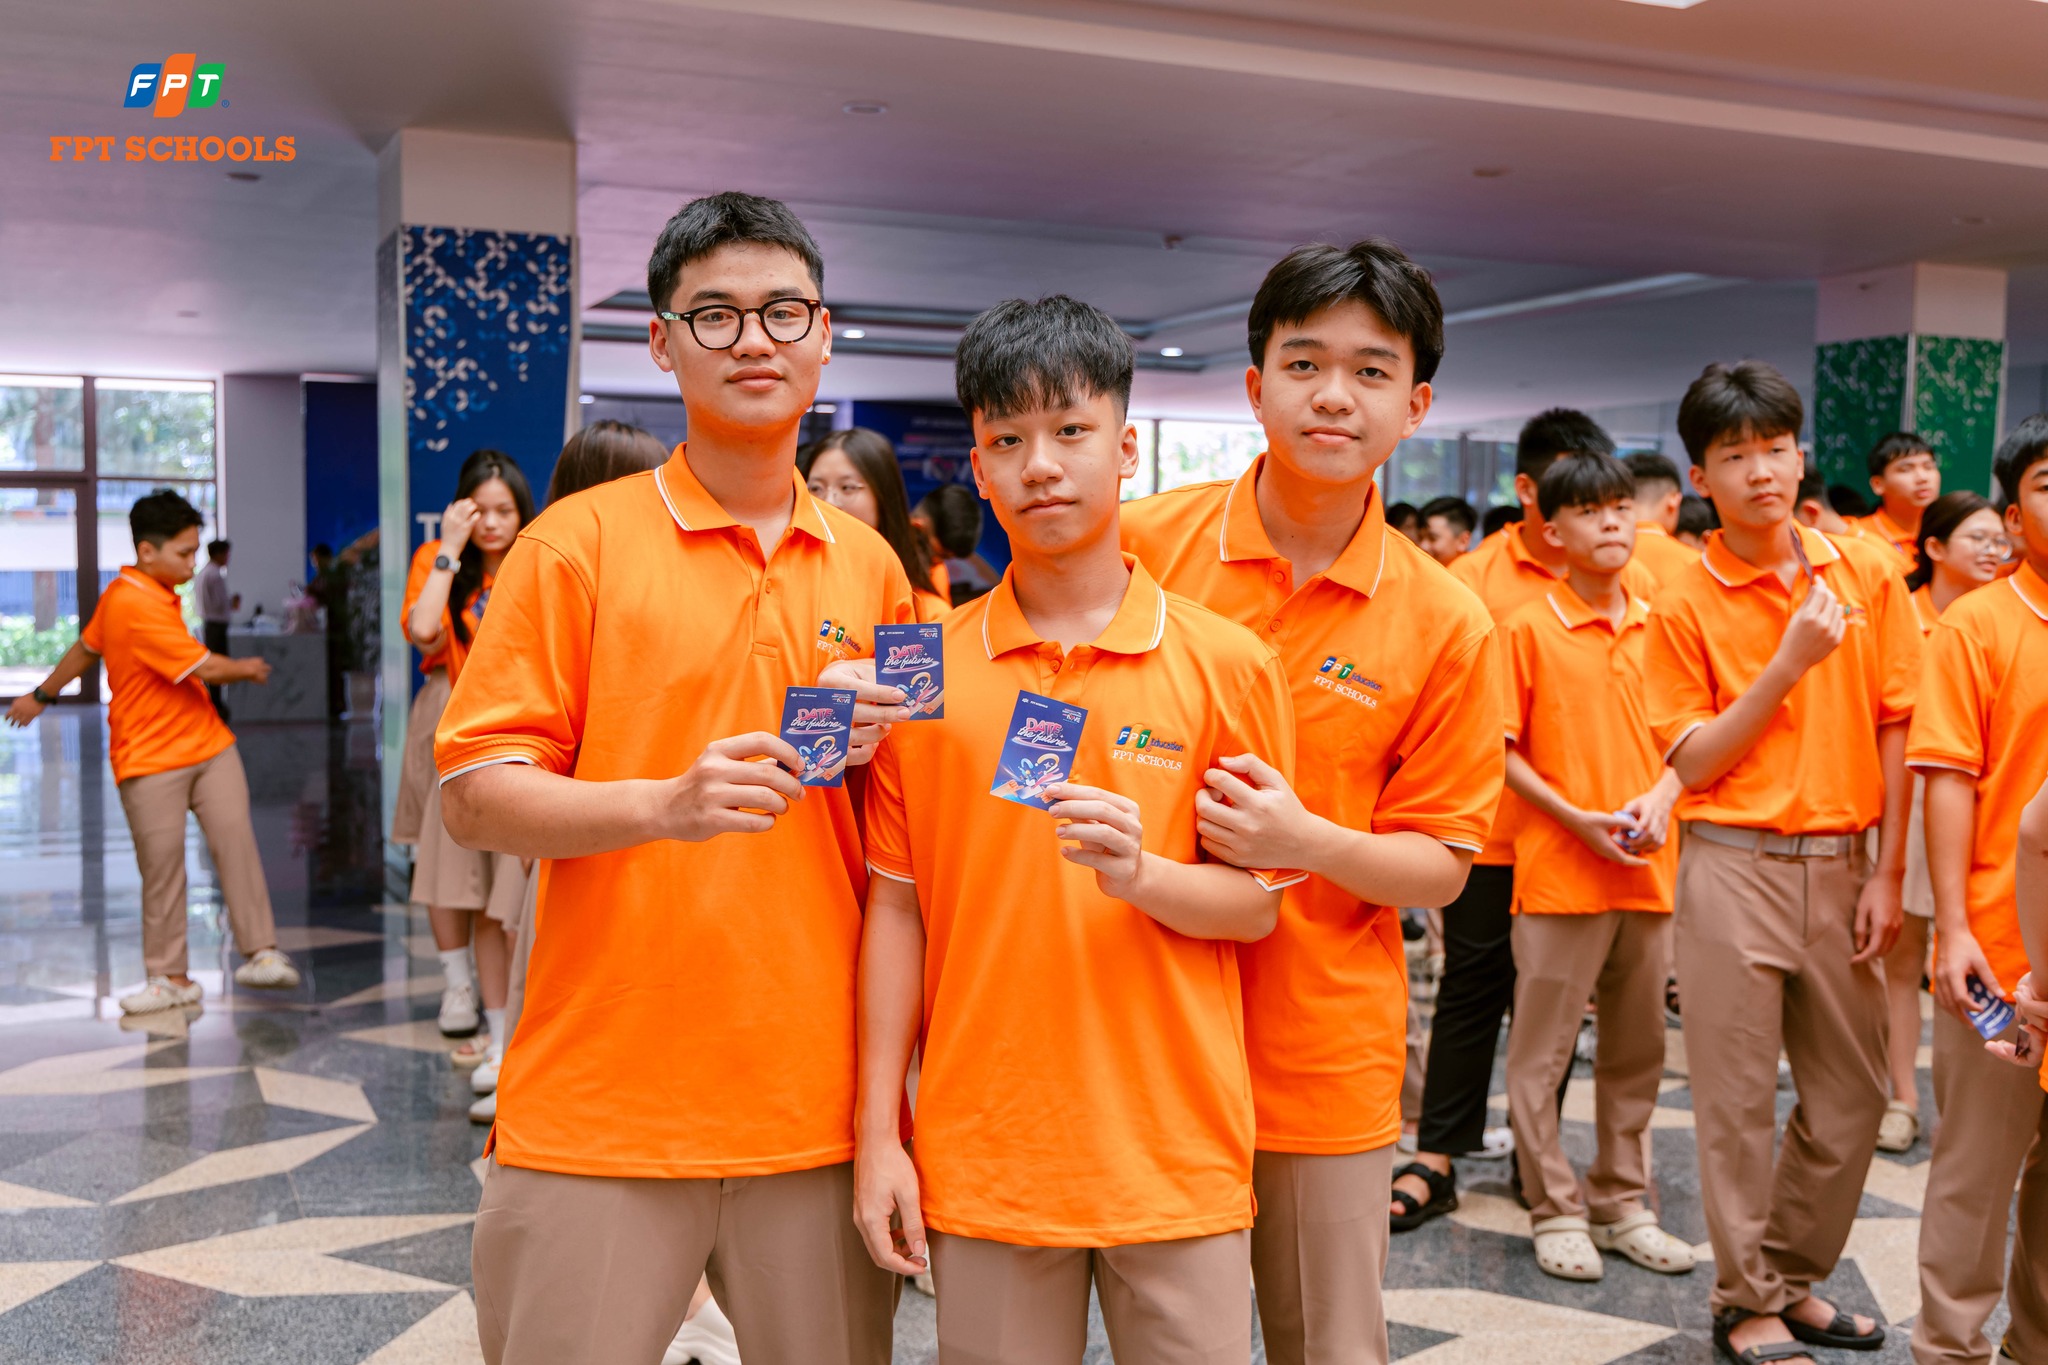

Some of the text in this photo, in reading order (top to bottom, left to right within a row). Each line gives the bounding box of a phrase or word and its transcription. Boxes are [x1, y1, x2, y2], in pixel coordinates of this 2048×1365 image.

[821, 622, 844, 639] FPT
[817, 639, 834, 653] FPT
[888, 644, 925, 660] DATE
[884, 655, 934, 669] the future
[1321, 659, 1352, 676] FPT
[1313, 675, 1378, 708] FPT SCHOOLS
[797, 707, 834, 721] DATE
[790, 716, 841, 731] the future
[1026, 717, 1063, 737] DATE
[1017, 725, 1068, 747] the future
[1118, 731, 1184, 752] FPT Education
[1112, 749, 1183, 770] FPT SCHOOLS
